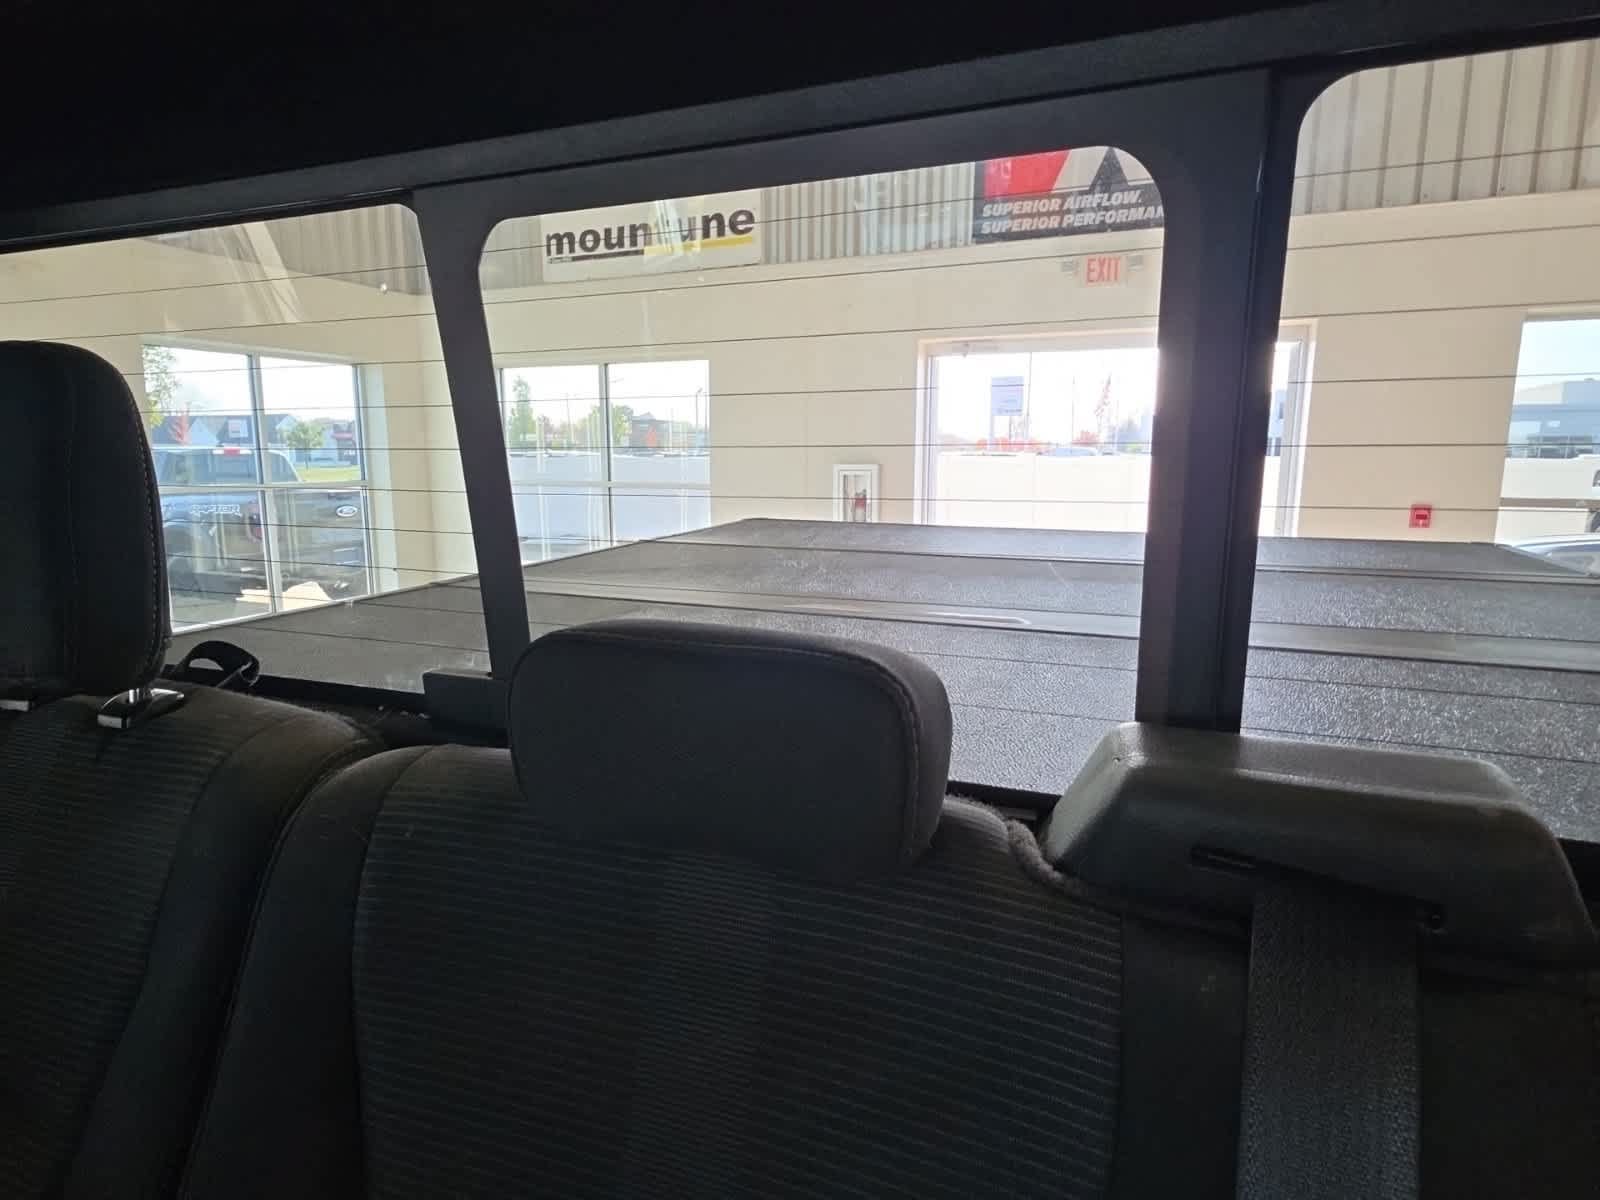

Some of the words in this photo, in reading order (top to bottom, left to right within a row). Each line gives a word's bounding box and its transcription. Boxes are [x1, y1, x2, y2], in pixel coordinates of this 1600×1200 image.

[982, 199, 1061, 217] SUPERIOR
[1063, 190, 1142, 210] AIRFLOW.
[981, 214, 1060, 234] SUPERIOR
[1086, 256, 1121, 284] EXIT
